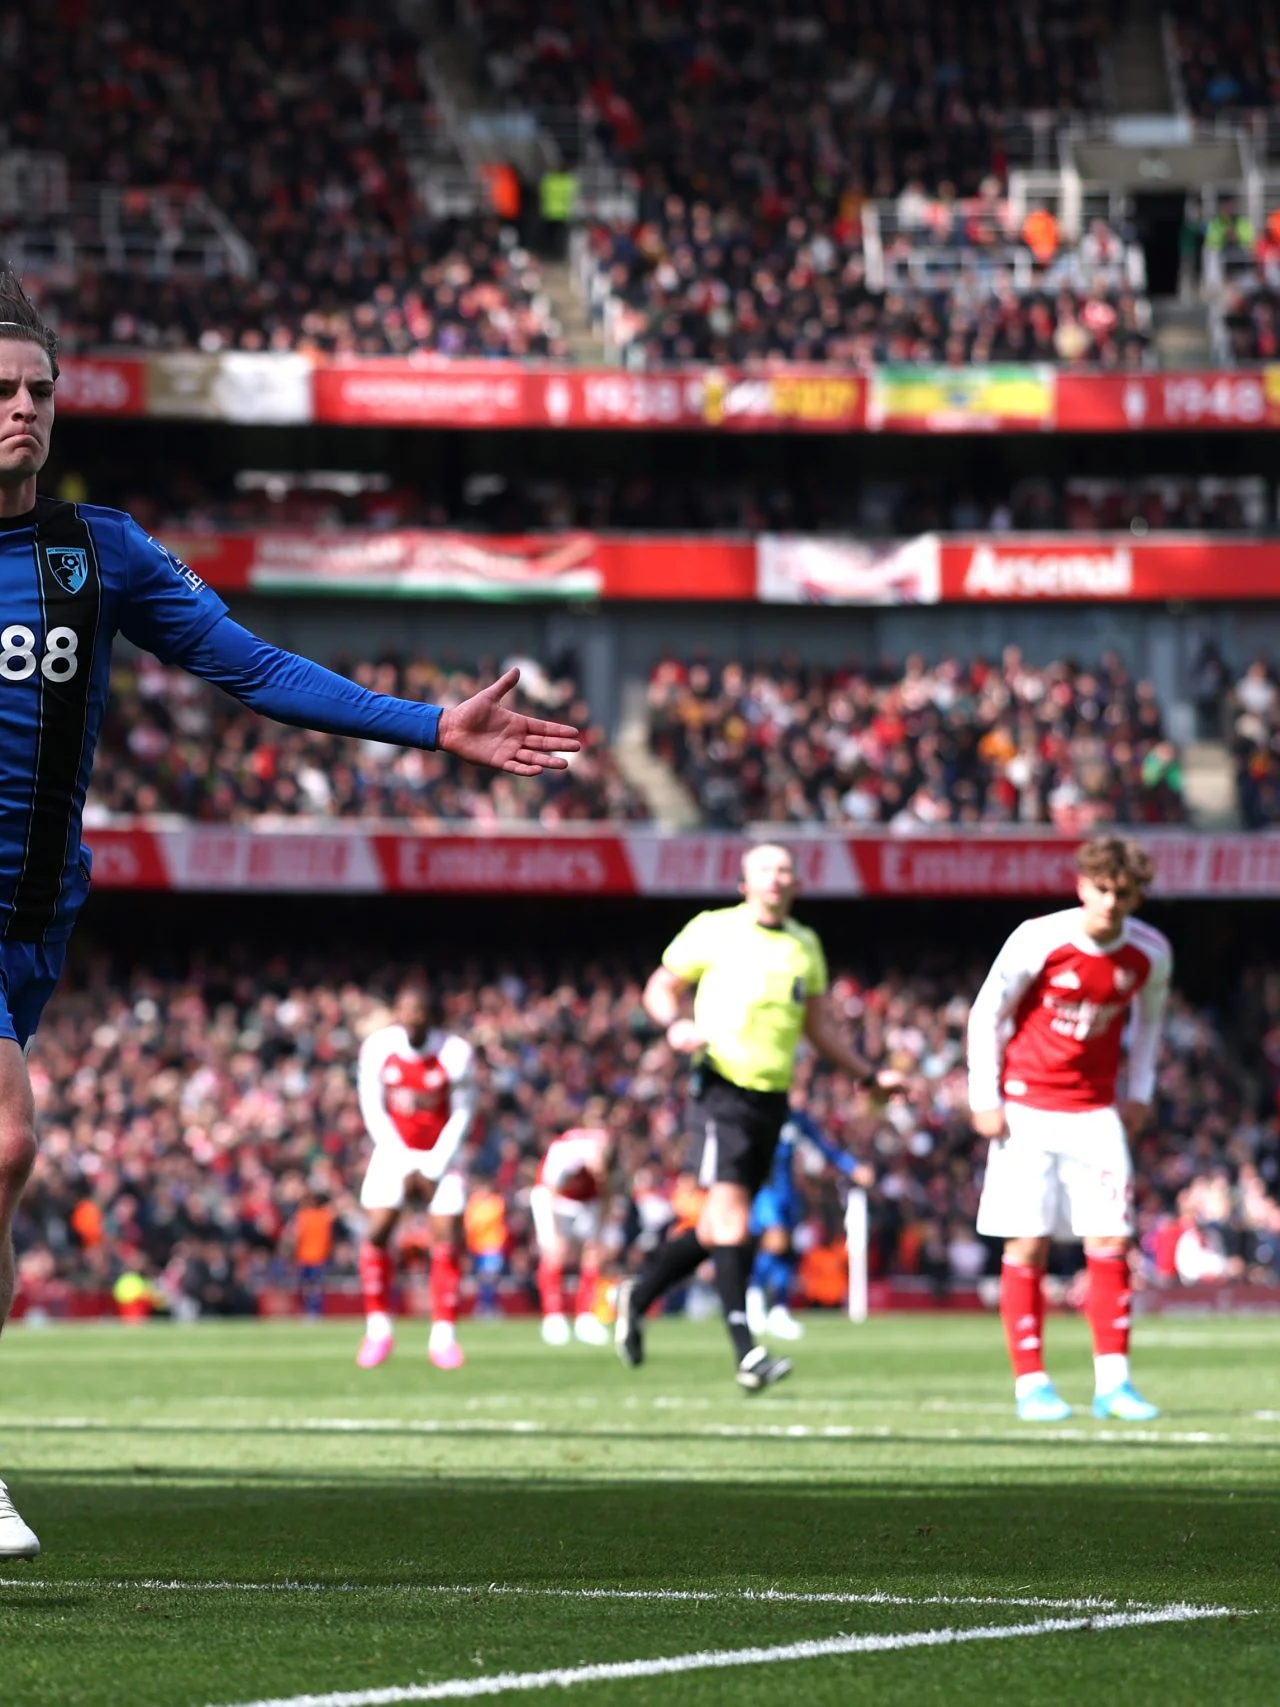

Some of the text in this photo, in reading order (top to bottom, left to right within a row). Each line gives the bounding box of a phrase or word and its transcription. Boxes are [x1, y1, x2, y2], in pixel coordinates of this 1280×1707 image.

[1163, 377, 1264, 423] 1948
[964, 542, 1133, 597] Arsenal
[398, 837, 609, 889] Emirates
